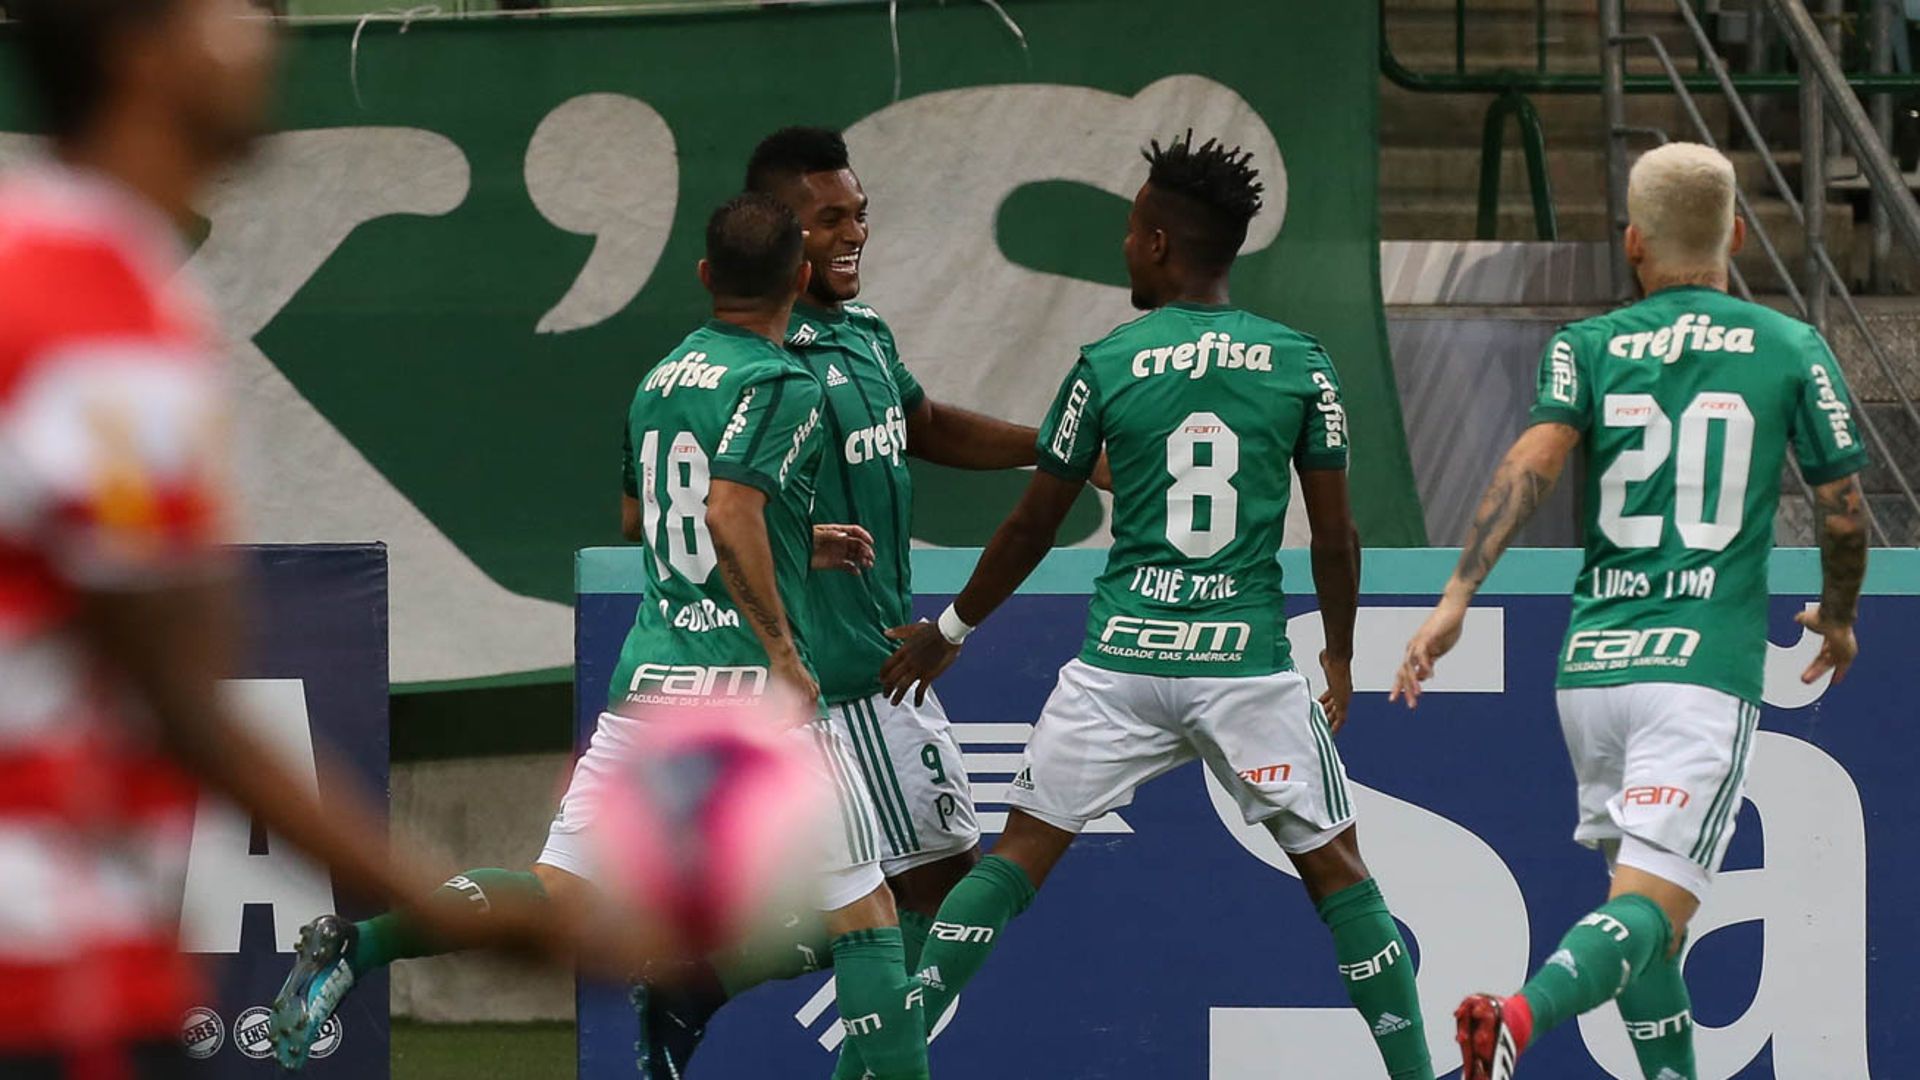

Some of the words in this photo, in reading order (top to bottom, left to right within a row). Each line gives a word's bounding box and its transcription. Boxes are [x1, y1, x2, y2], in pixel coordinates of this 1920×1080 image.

[1131, 331, 1272, 379] crefisa
[1608, 313, 1755, 364] crefisa
[1166, 412, 1239, 558] 8
[1598, 392, 1755, 552] 20
[639, 430, 717, 584] 18
[1097, 643, 1155, 660] FACULDADE
[1158, 651, 1182, 661] DAS
[921, 743, 946, 785] 9
